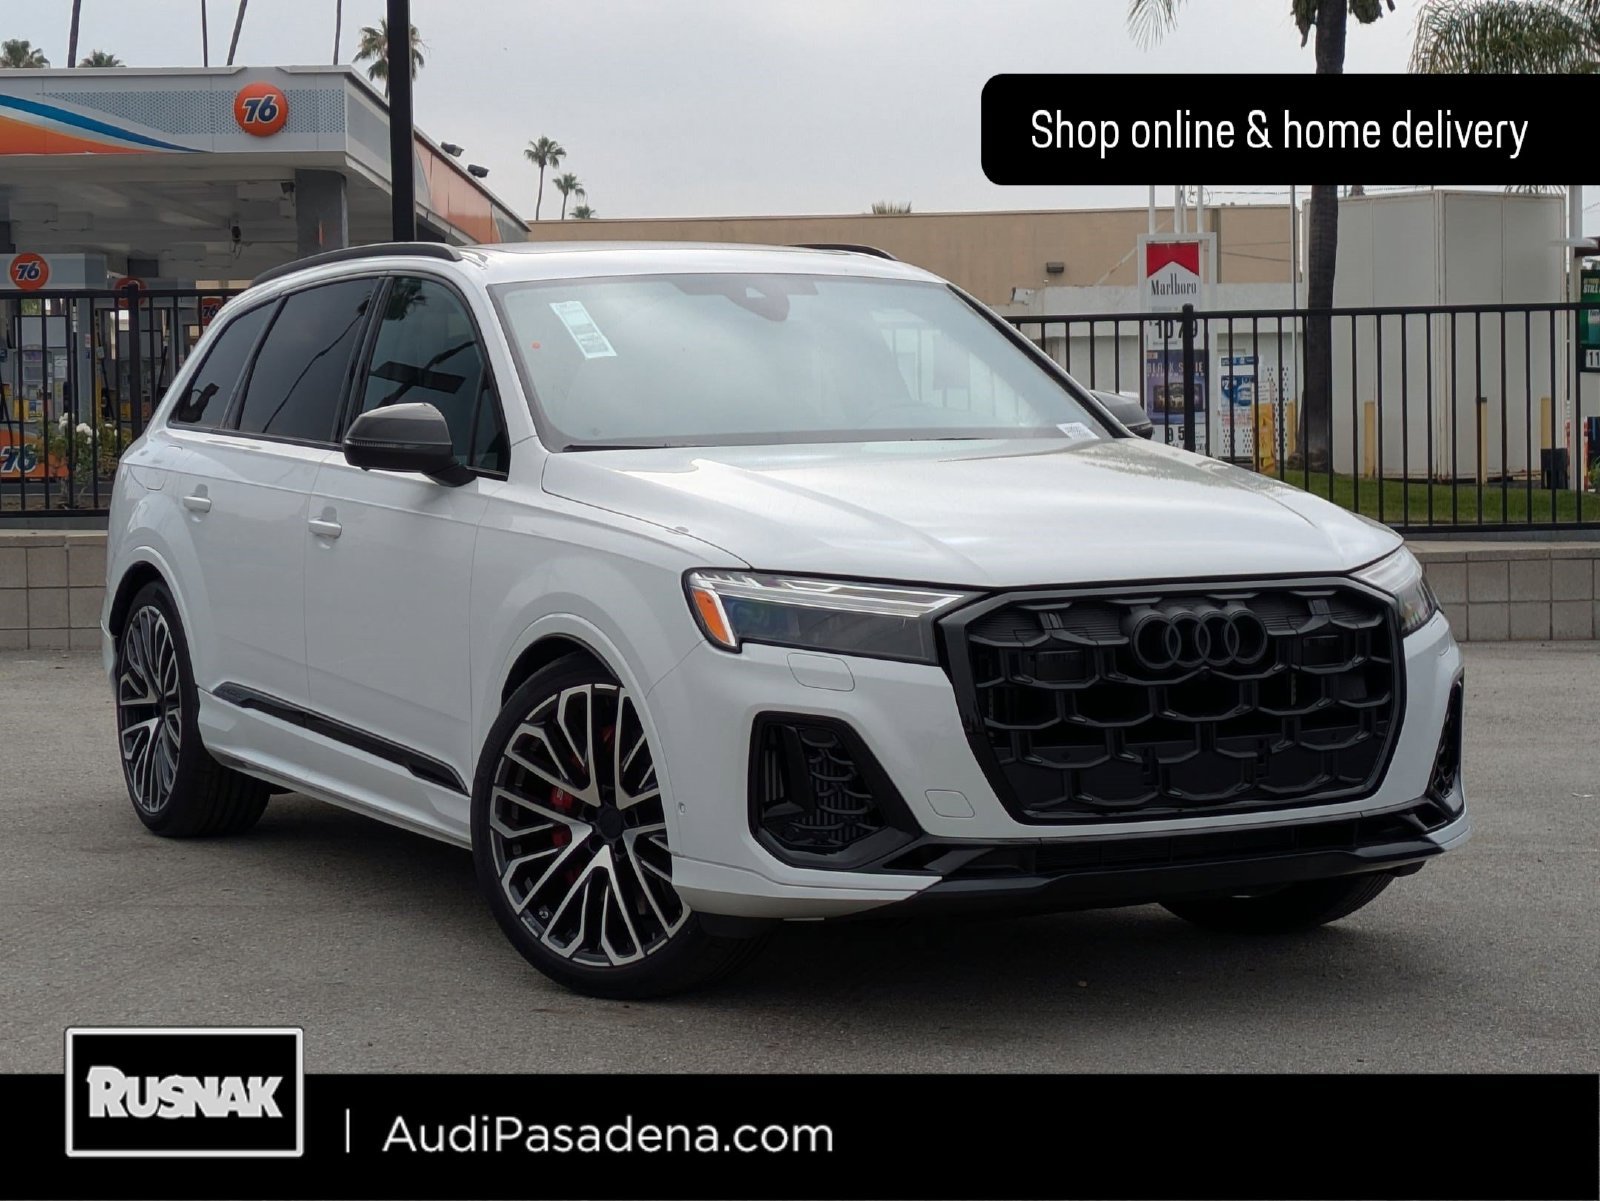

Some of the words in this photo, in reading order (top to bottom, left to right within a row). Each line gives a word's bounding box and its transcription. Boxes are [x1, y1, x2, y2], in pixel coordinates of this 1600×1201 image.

[242, 94, 279, 124] 76
[16, 260, 41, 281] 76
[1151, 272, 1198, 296] Marlboro
[0, 444, 37, 473] 76
